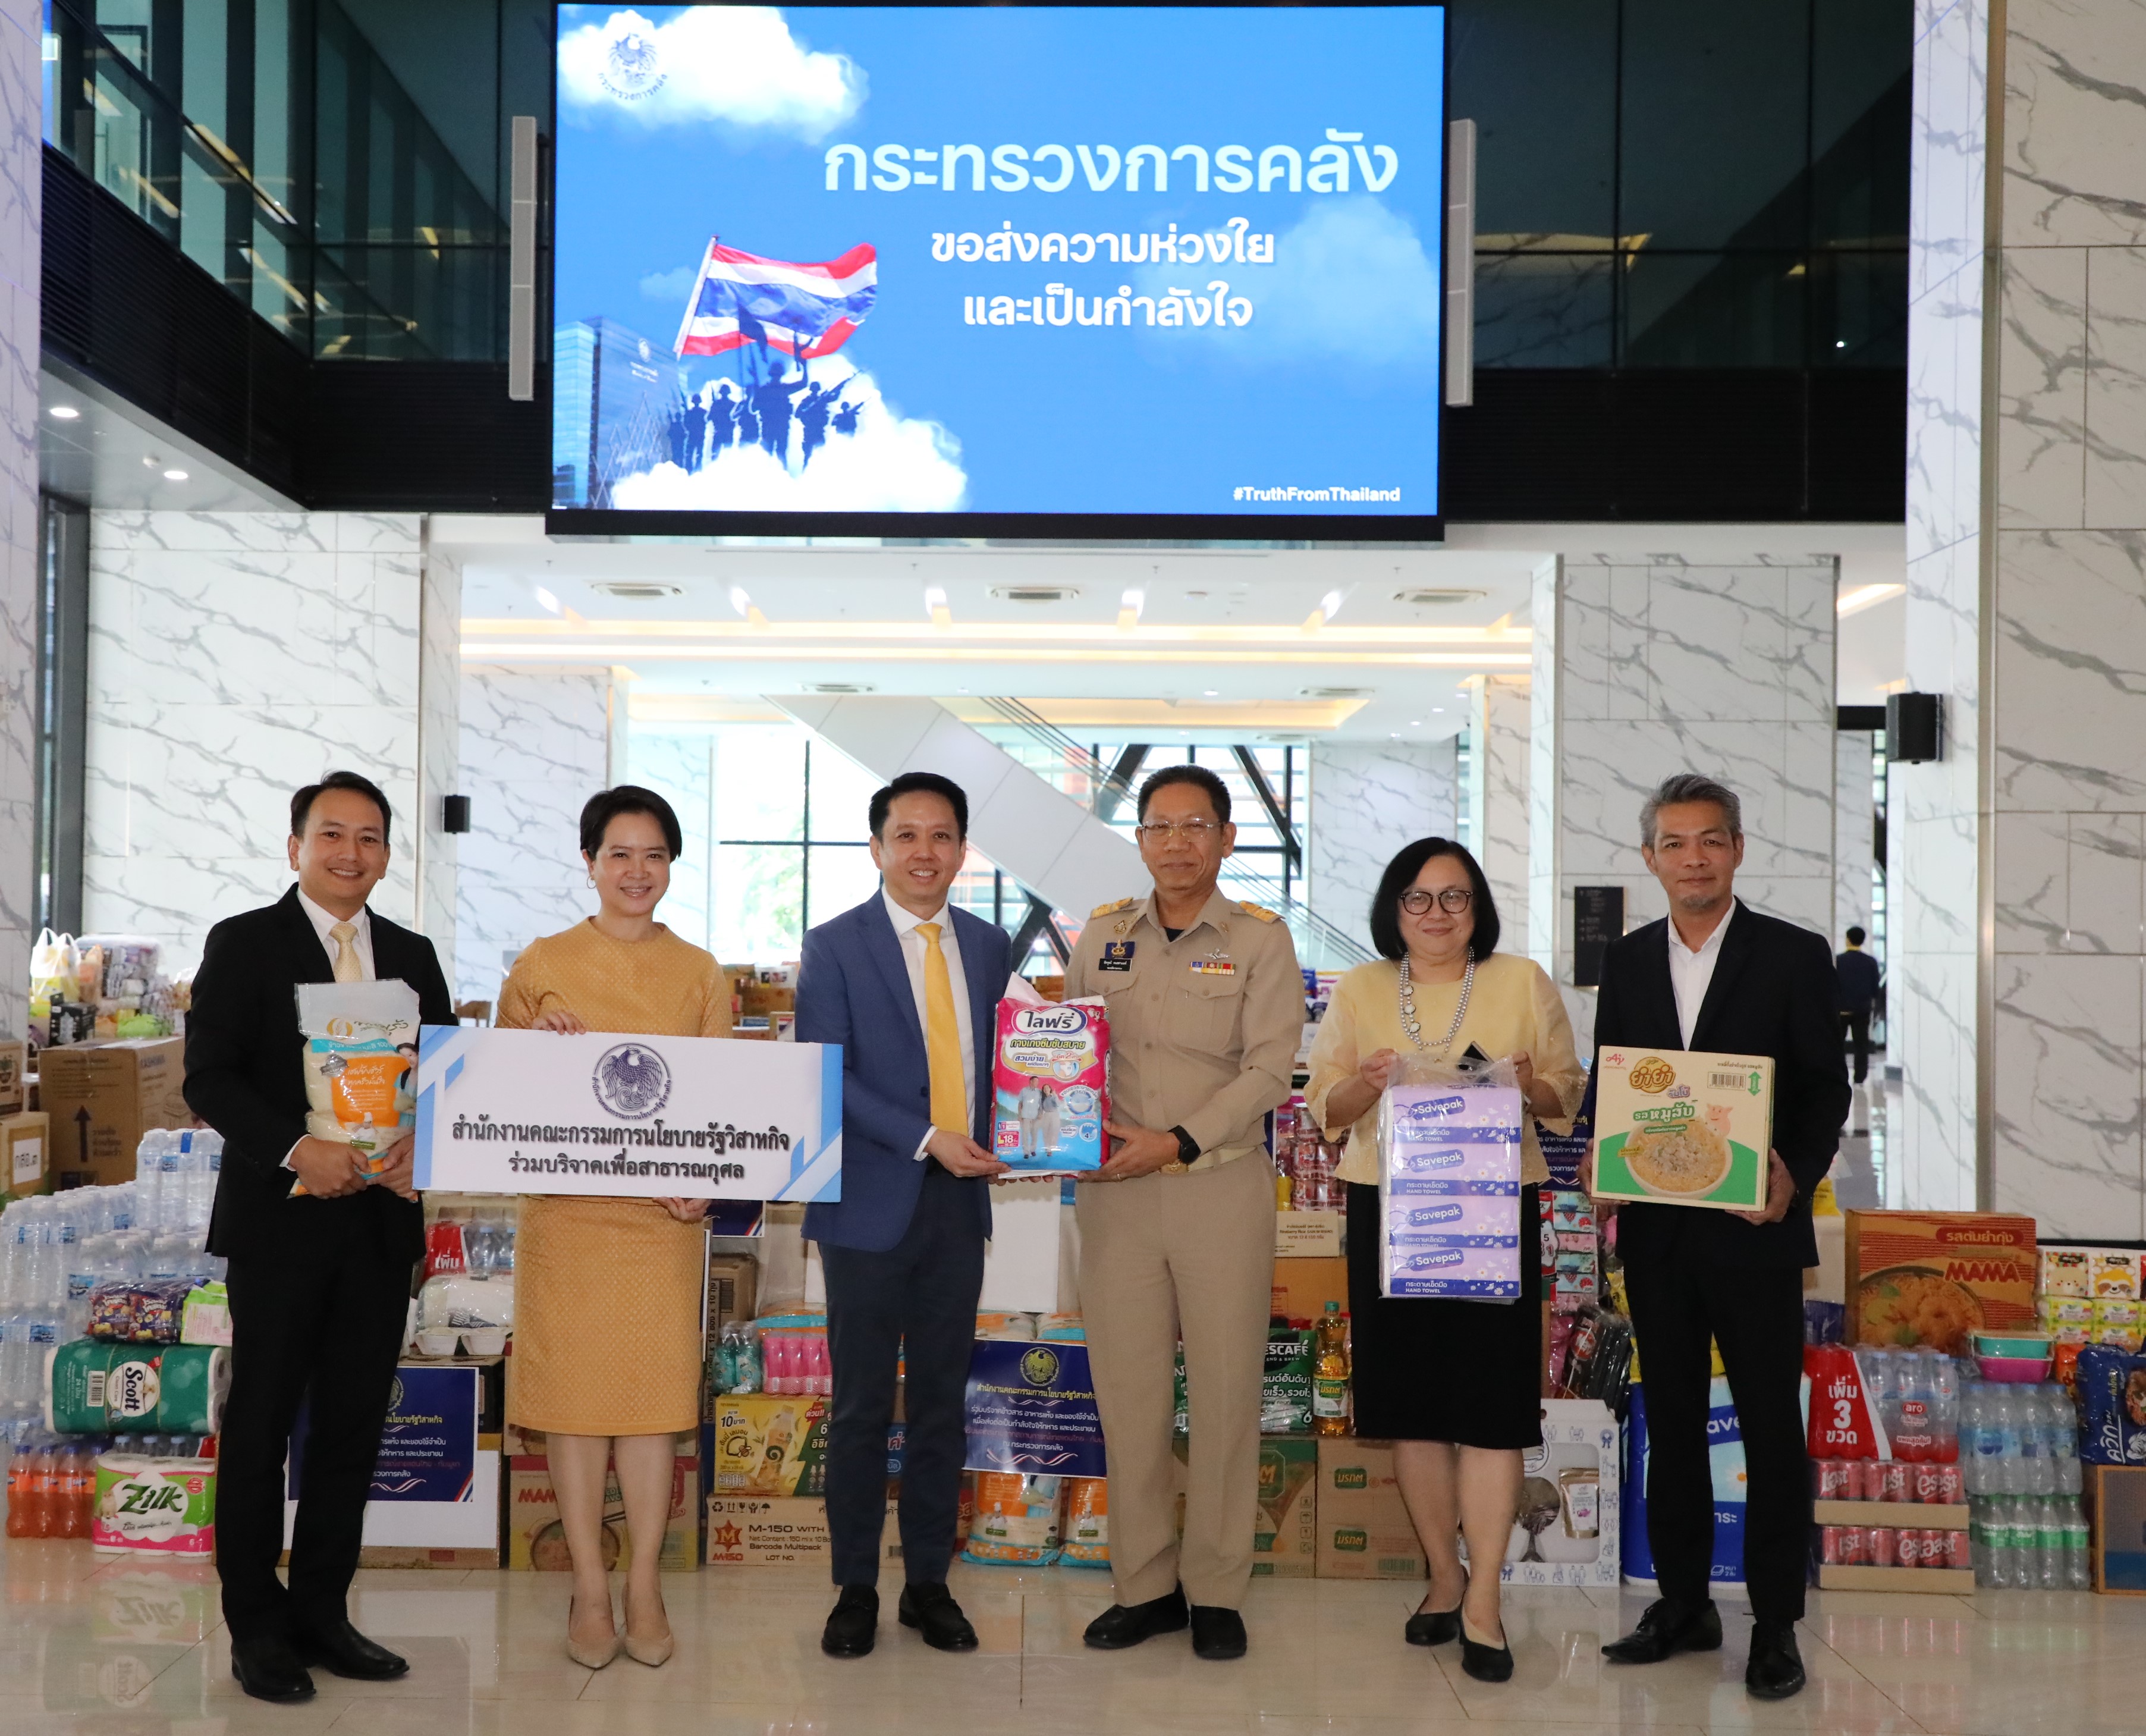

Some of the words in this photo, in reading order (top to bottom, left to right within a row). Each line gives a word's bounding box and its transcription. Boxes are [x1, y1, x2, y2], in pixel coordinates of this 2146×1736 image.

[825, 128, 1399, 193] กระทรวงการคลัง
[931, 217, 1274, 264] ขอส่งความห่วงใย
[964, 281, 1254, 327] และเป็นกำลังใจ
[1233, 486, 1400, 503] #TruthFromThailand
[1417, 1098, 1464, 1115] Savepak
[452, 1115, 790, 1154] สำนักงานคณะกรรมการนโยบายรัฐวิสาหกิจ
[508, 1149, 744, 1184] ร่วมบริจาคเพื่อสาธารณกุศล
[1416, 1151, 1462, 1167] Savepak
[1415, 1206, 1461, 1222] Savepak
[1416, 1251, 1462, 1266] Savepak
[1944, 1261, 2021, 1283] MAMA
[1405, 1280, 1448, 1289] กระดาษเช็ดมือ
[1265, 1339, 1309, 1356] ESCAFÉ
[125, 1367, 143, 1411] Scott
[1833, 1399, 1852, 1429] 3
[1905, 1403, 1924, 1413] aro
[1826, 1430, 1858, 1445] ขวด
[117, 1483, 183, 1515] Zilk
[518, 1488, 558, 1503] MAM
[749, 1524, 793, 1533] M-150
